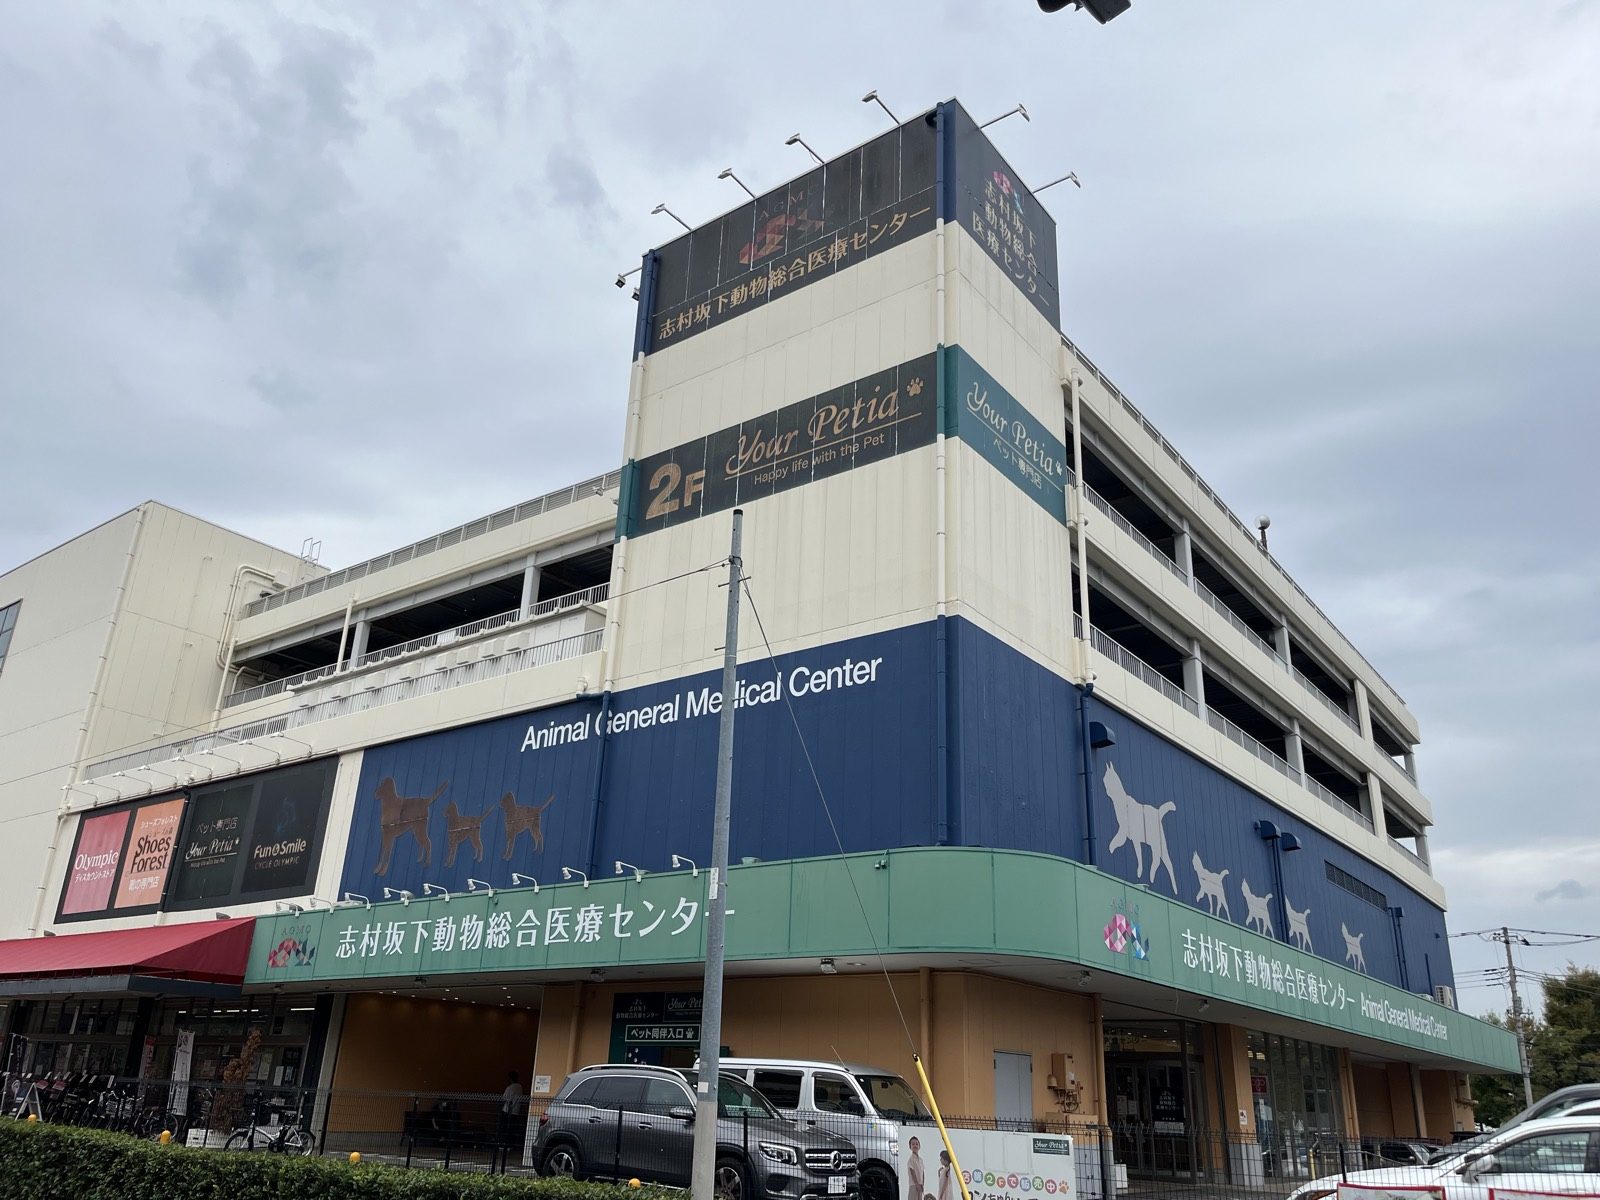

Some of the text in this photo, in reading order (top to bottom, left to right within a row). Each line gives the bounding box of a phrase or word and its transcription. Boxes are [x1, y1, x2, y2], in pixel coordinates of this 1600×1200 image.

[658, 206, 931, 340] 志村坂下動物総合医療センター
[725, 385, 900, 475] Your Petia
[966, 381, 1054, 476] Your Petia
[754, 432, 885, 486] Happy life with the Pet
[645, 462, 706, 521] 2F
[520, 712, 591, 753] Animal
[595, 693, 680, 736] General
[788, 656, 883, 696] Center
[74, 850, 119, 871] Olympic
[130, 853, 169, 875] Forest
[135, 834, 172, 857] Shoes
[185, 836, 234, 860] Your Petia
[254, 856, 300, 871] CYCLE OLYMPIC
[688, 996, 703, 1008] Pet
[1181, 928, 1448, 1041] 志村坂下動物総合医療センター Animal General Medical Center
[630, 1028, 684, 1039] ペット同伴入口
